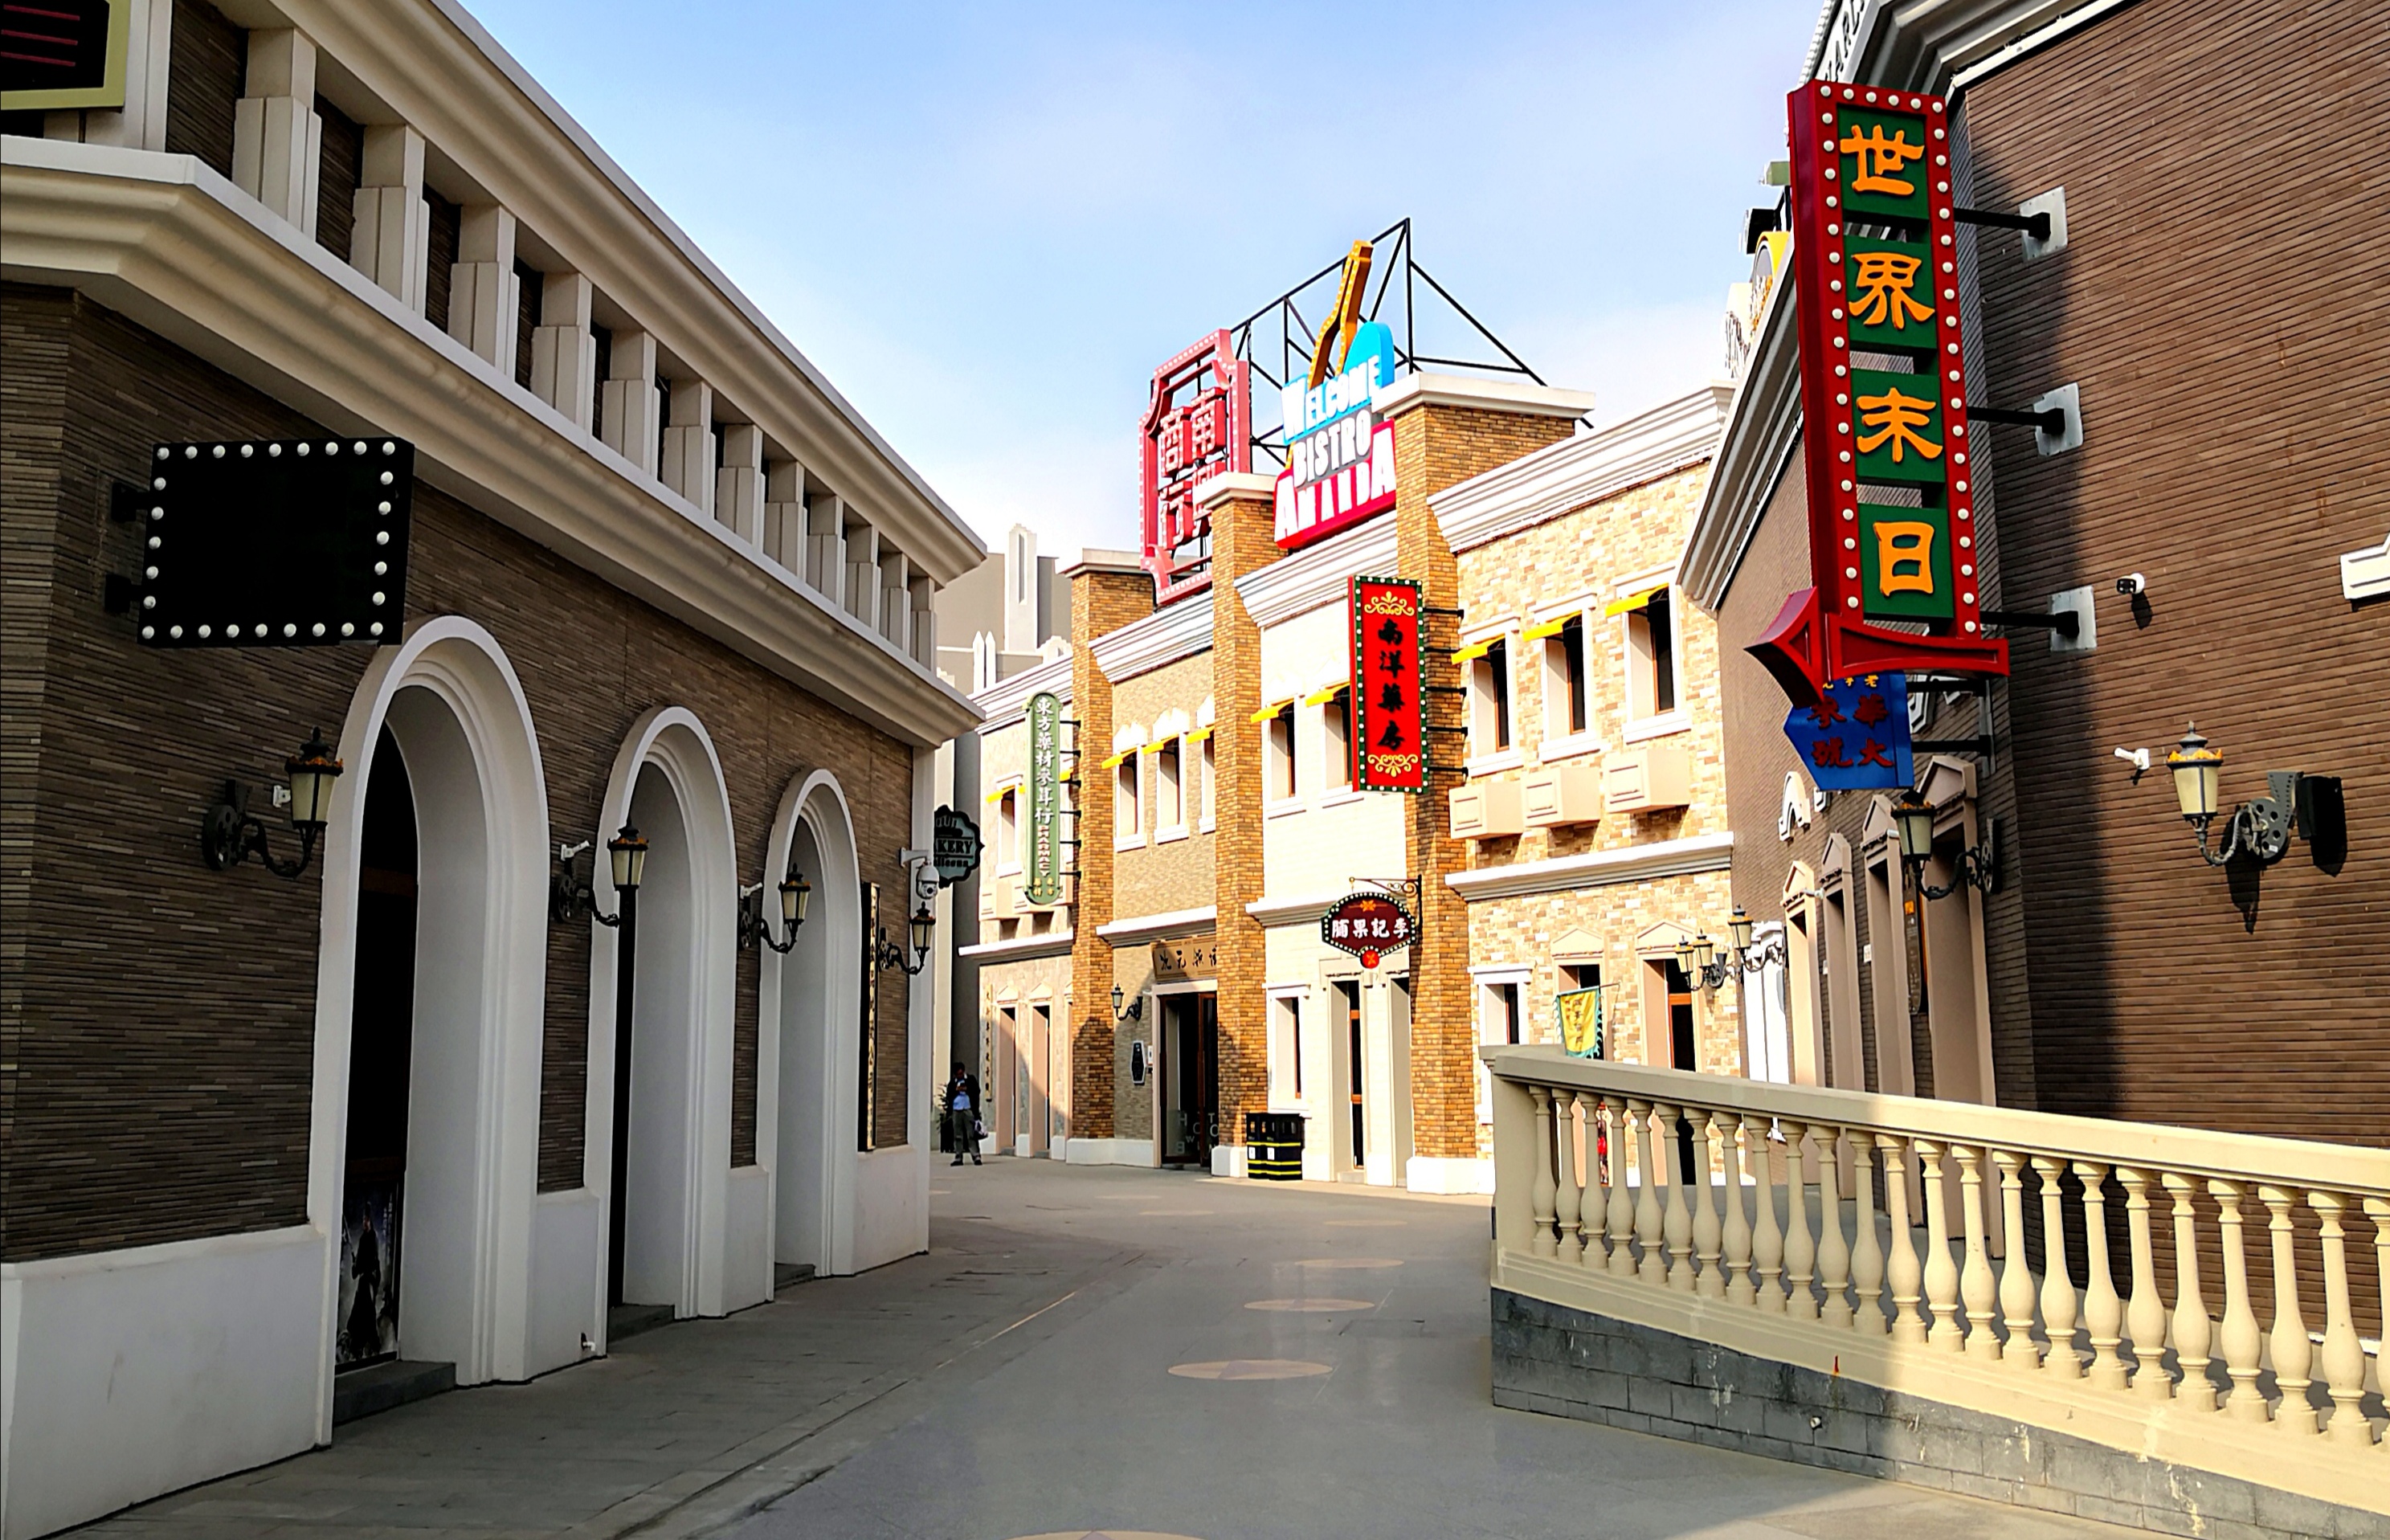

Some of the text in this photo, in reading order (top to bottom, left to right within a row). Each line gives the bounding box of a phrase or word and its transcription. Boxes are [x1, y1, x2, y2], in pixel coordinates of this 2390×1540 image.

[1281, 354, 1381, 441] WELCOME
[1840, 125, 1944, 597] 世界末日
[1274, 427, 1396, 542] AMANDA
[1293, 409, 1371, 488] BISTRO
[934, 839, 973, 854] KERY
[1037, 825, 1051, 877] PHARMACY
